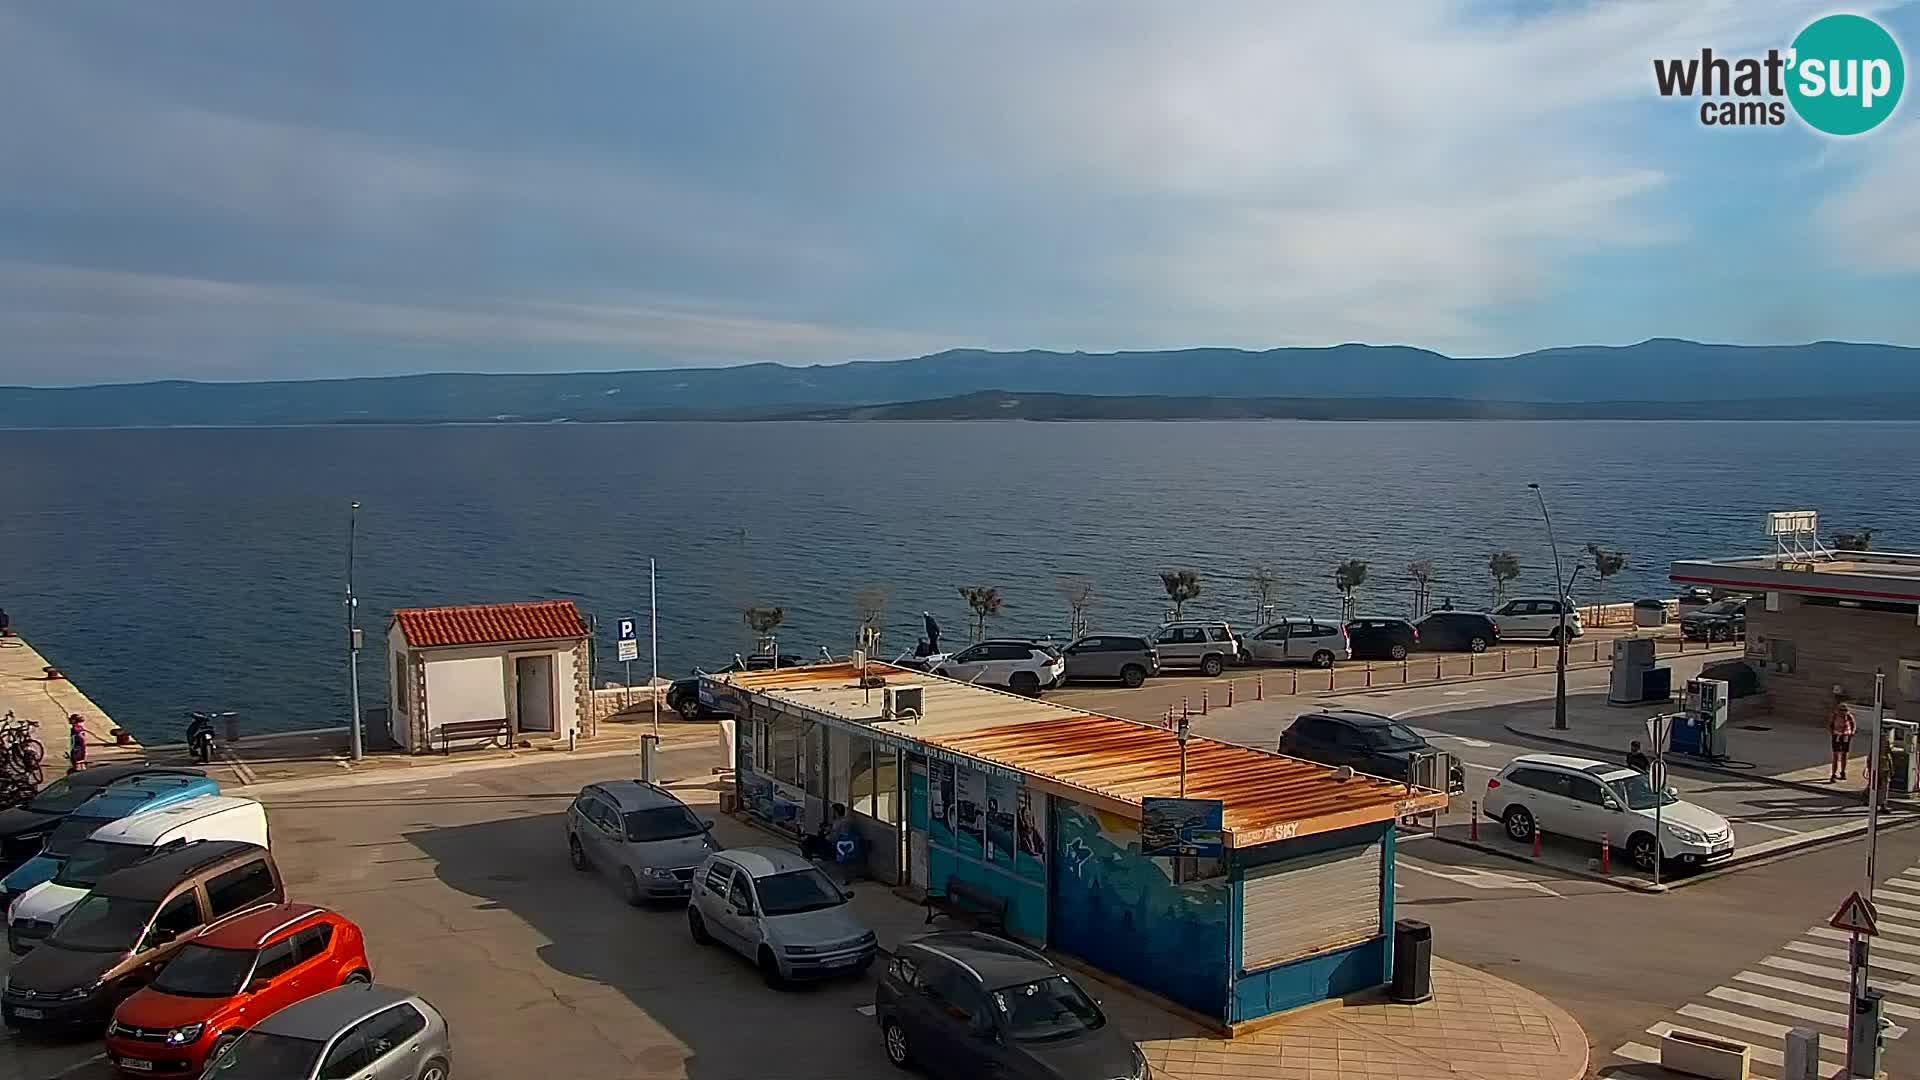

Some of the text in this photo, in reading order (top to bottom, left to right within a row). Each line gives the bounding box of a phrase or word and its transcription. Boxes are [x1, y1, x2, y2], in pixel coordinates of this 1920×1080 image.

[621, 621, 633, 638] P
[939, 751, 969, 767] STATION
[971, 759, 995, 775] TICKET
[996, 766, 1021, 783] OFFICE
